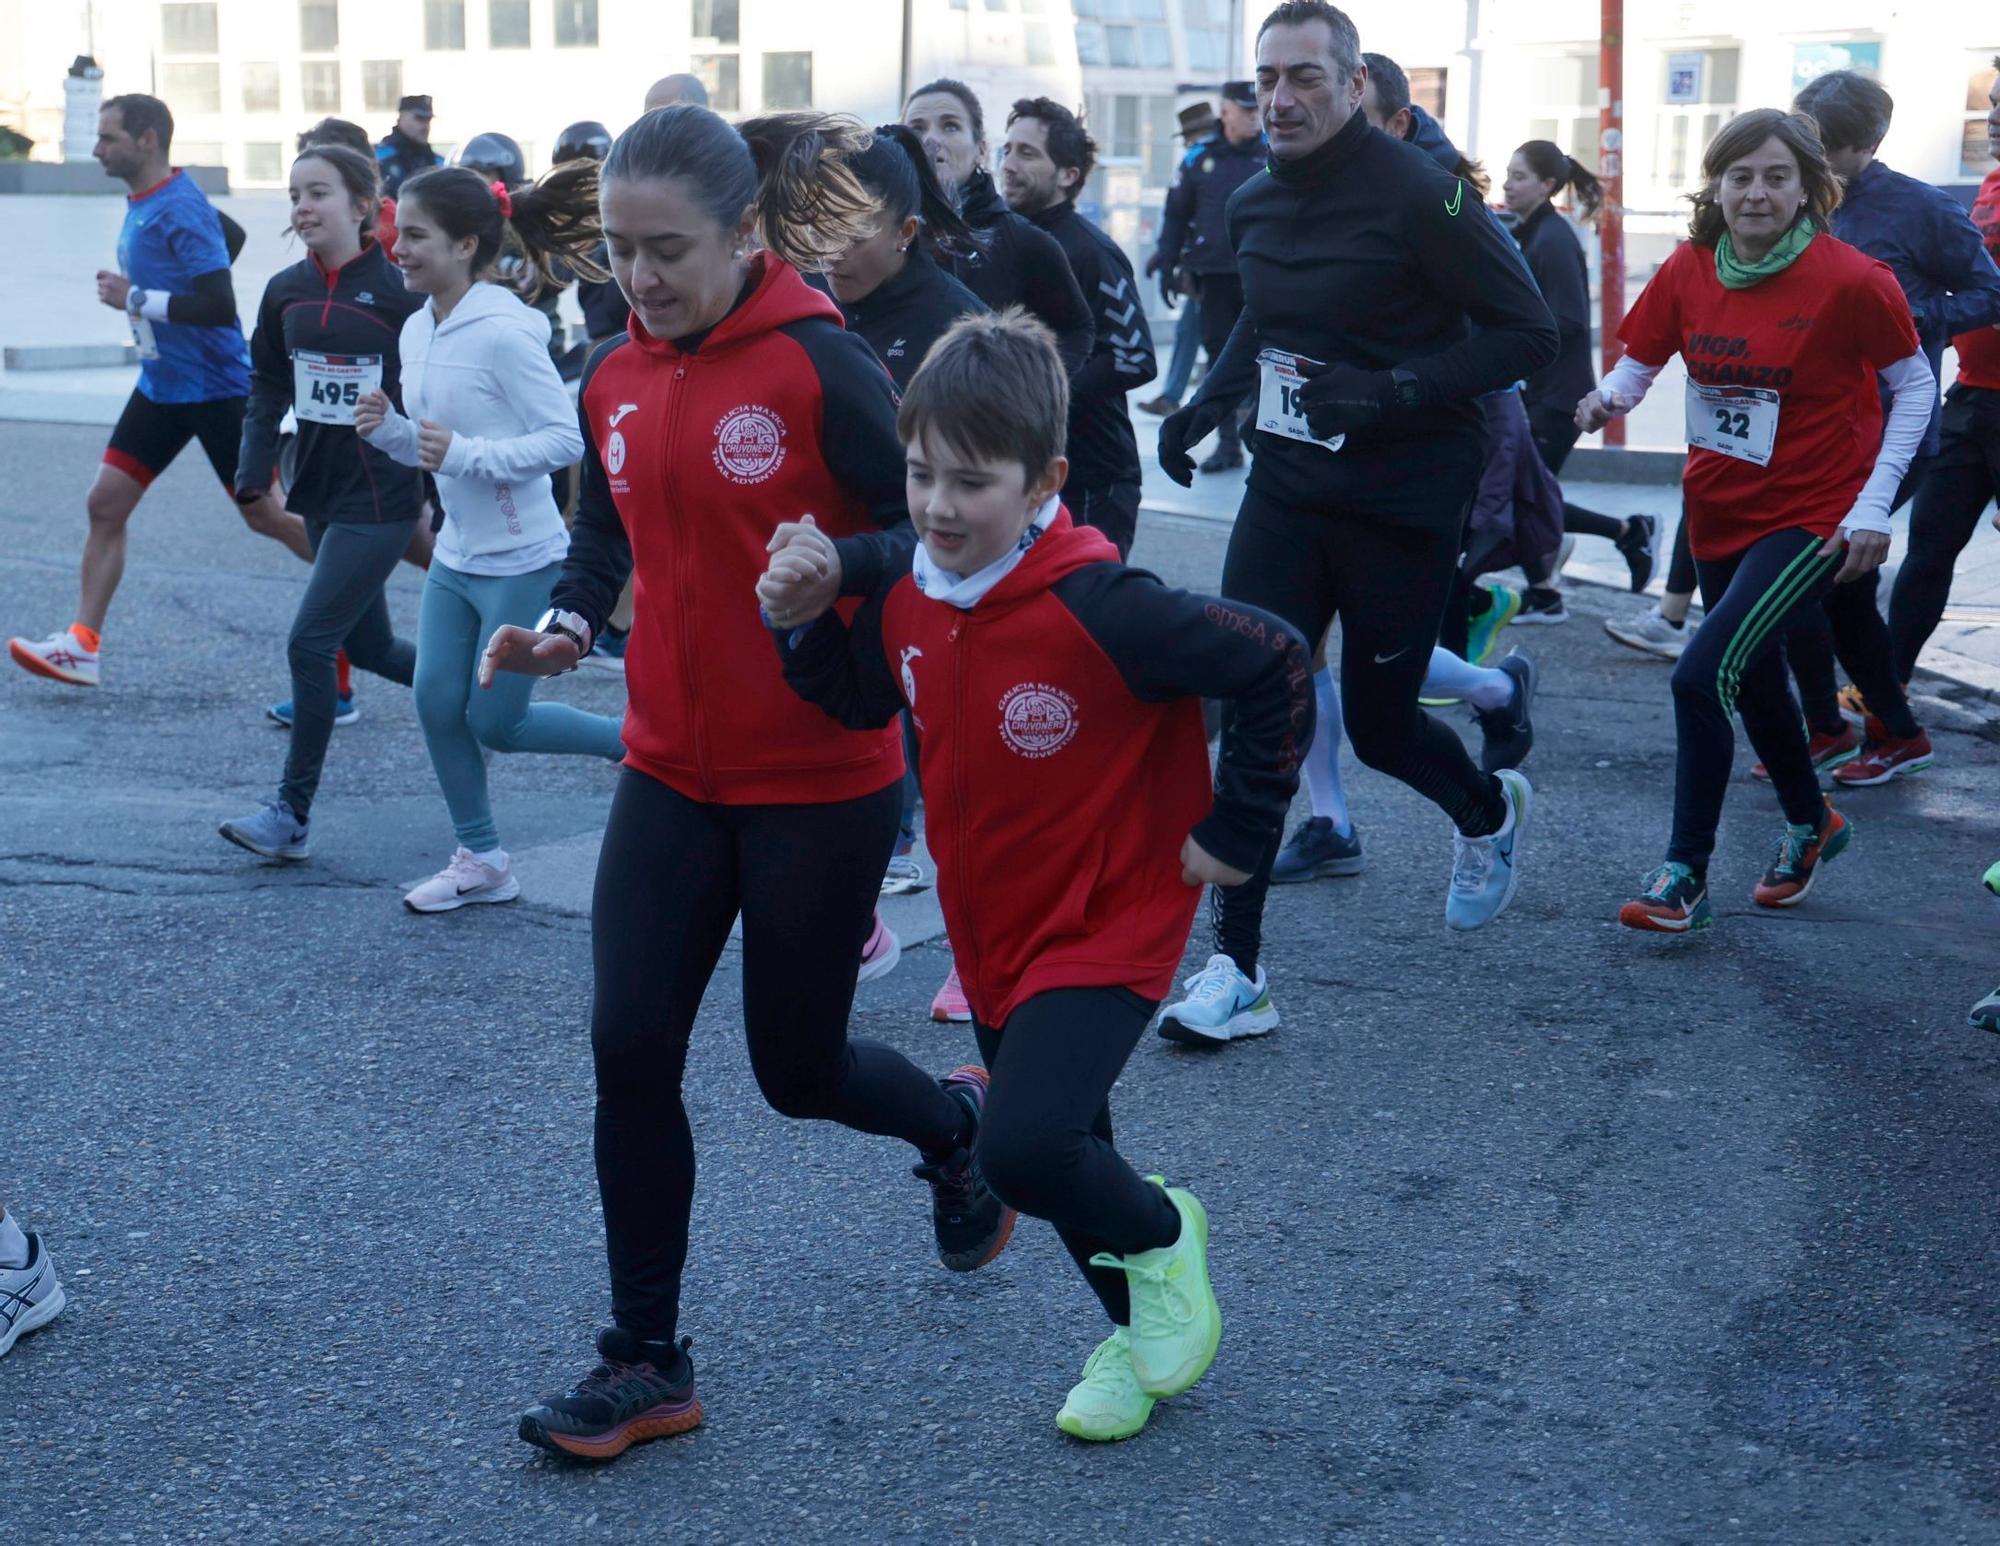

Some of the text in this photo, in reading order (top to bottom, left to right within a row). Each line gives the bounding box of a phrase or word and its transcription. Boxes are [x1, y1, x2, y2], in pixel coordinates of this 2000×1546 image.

[311, 380, 360, 407] 495
[713, 404, 787, 437] GALICIA MAXICA
[1714, 408, 1750, 440] 22
[724, 444, 774, 454] CHUVONERS
[711, 447, 787, 485] TRAIL ADVENTURE
[1011, 720, 1065, 731] CHUVONERS
